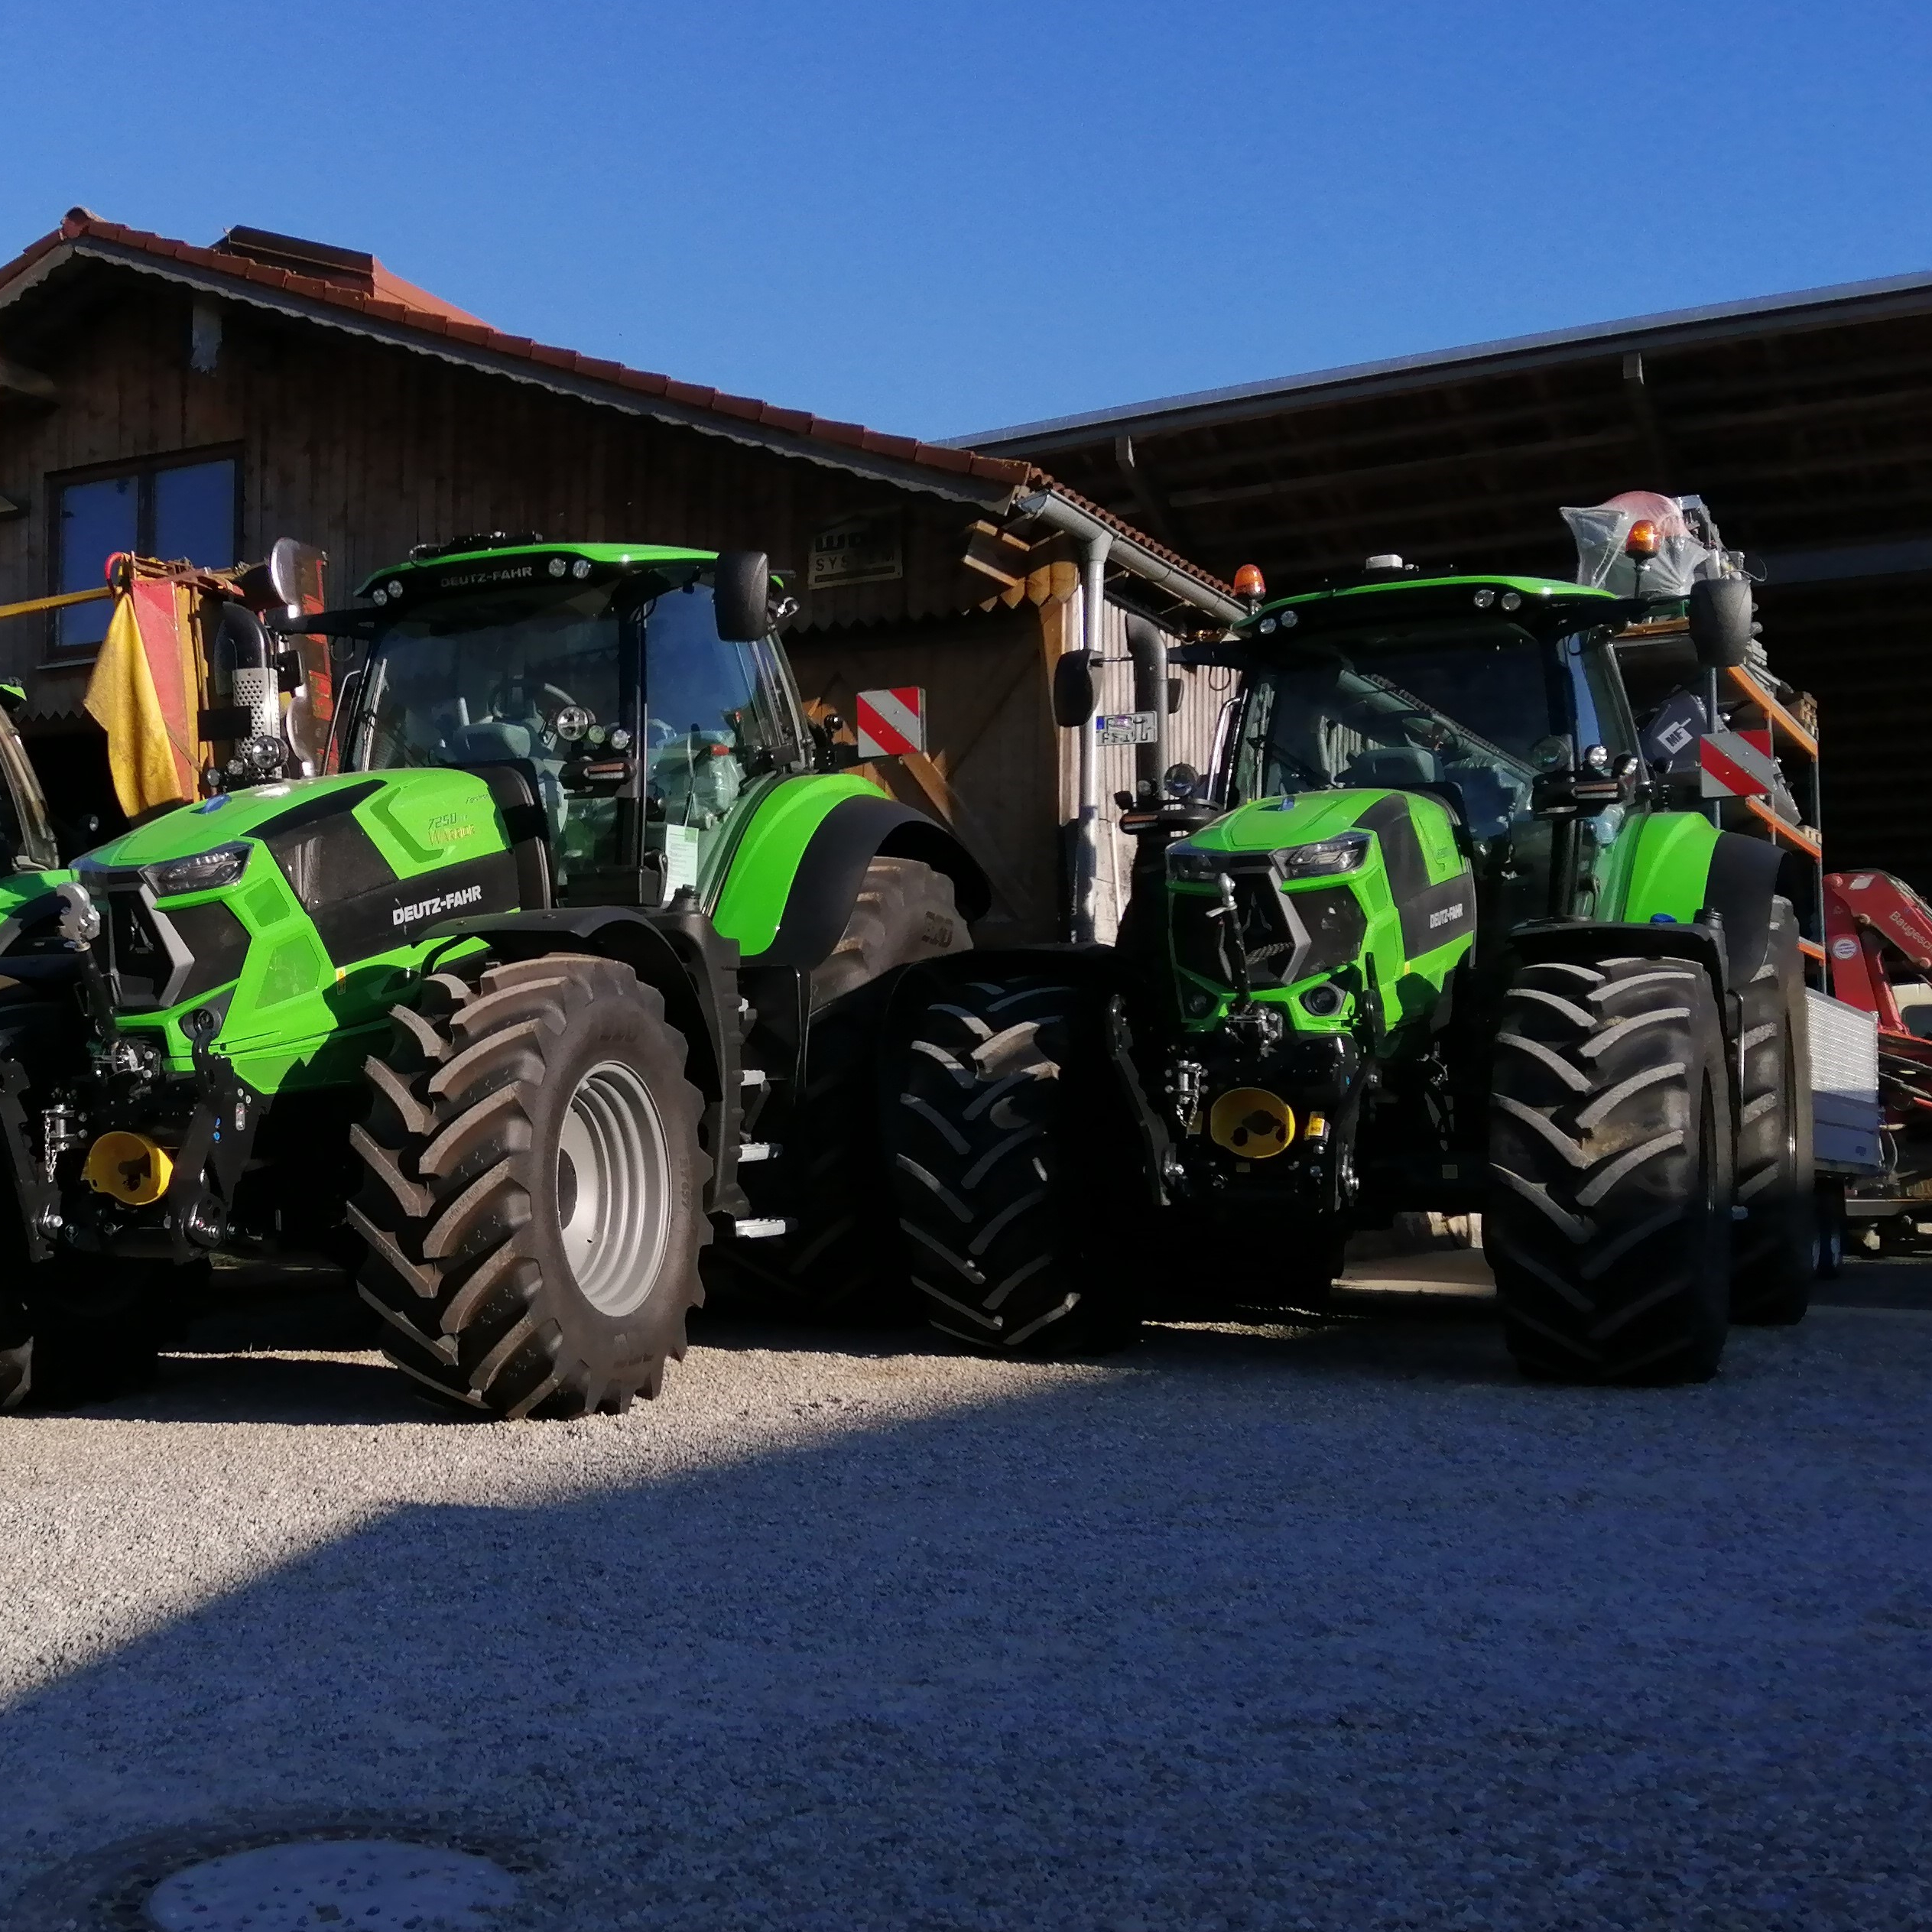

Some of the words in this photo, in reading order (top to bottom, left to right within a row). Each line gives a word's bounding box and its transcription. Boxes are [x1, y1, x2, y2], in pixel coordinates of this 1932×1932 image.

[441, 567, 532, 587] DEUTZ-FAHR
[427, 812, 457, 830] 7250
[392, 885, 482, 926] DEUTZ-FAHR
[1430, 903, 1463, 929] DEUTZ-FAHR
